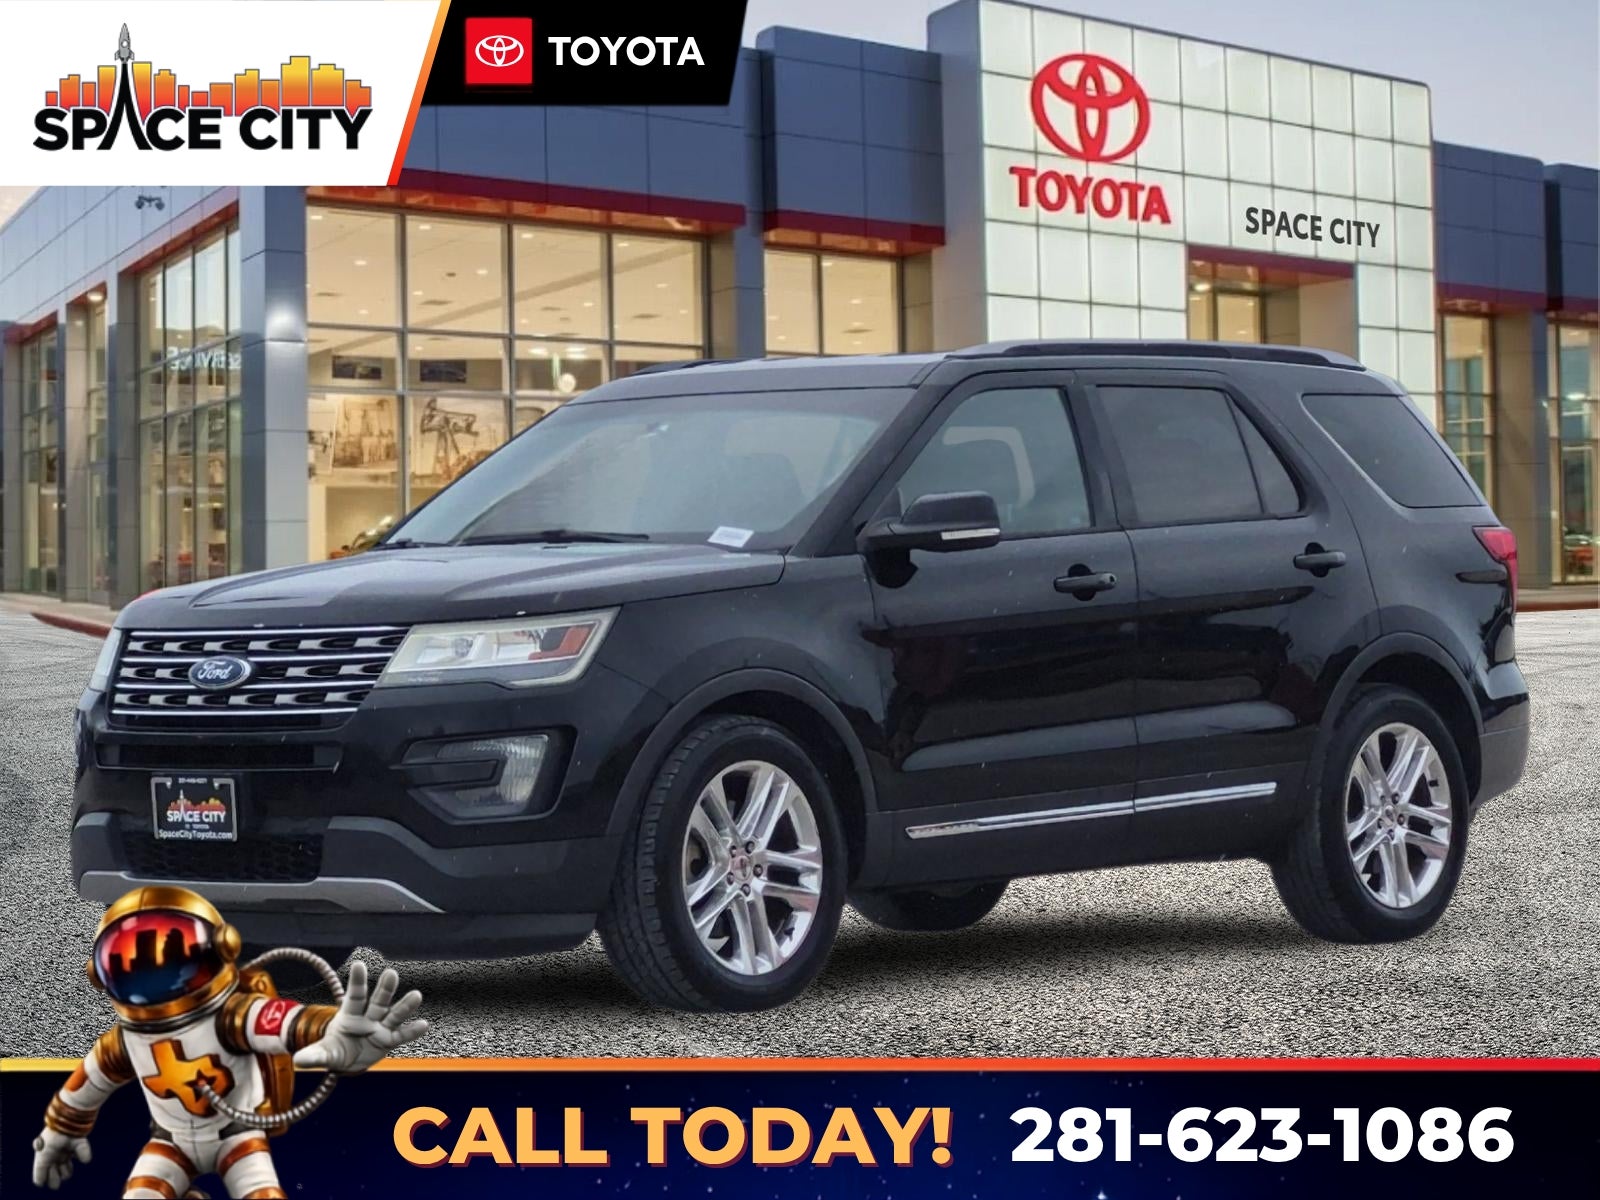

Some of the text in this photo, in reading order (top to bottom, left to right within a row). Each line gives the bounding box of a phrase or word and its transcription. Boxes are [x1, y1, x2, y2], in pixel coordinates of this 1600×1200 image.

[1010, 166, 1171, 224] TOYOTA
[1245, 206, 1381, 248] SPACE CITY
[197, 660, 233, 680] Ford
[166, 810, 226, 823] SPACE CITY
